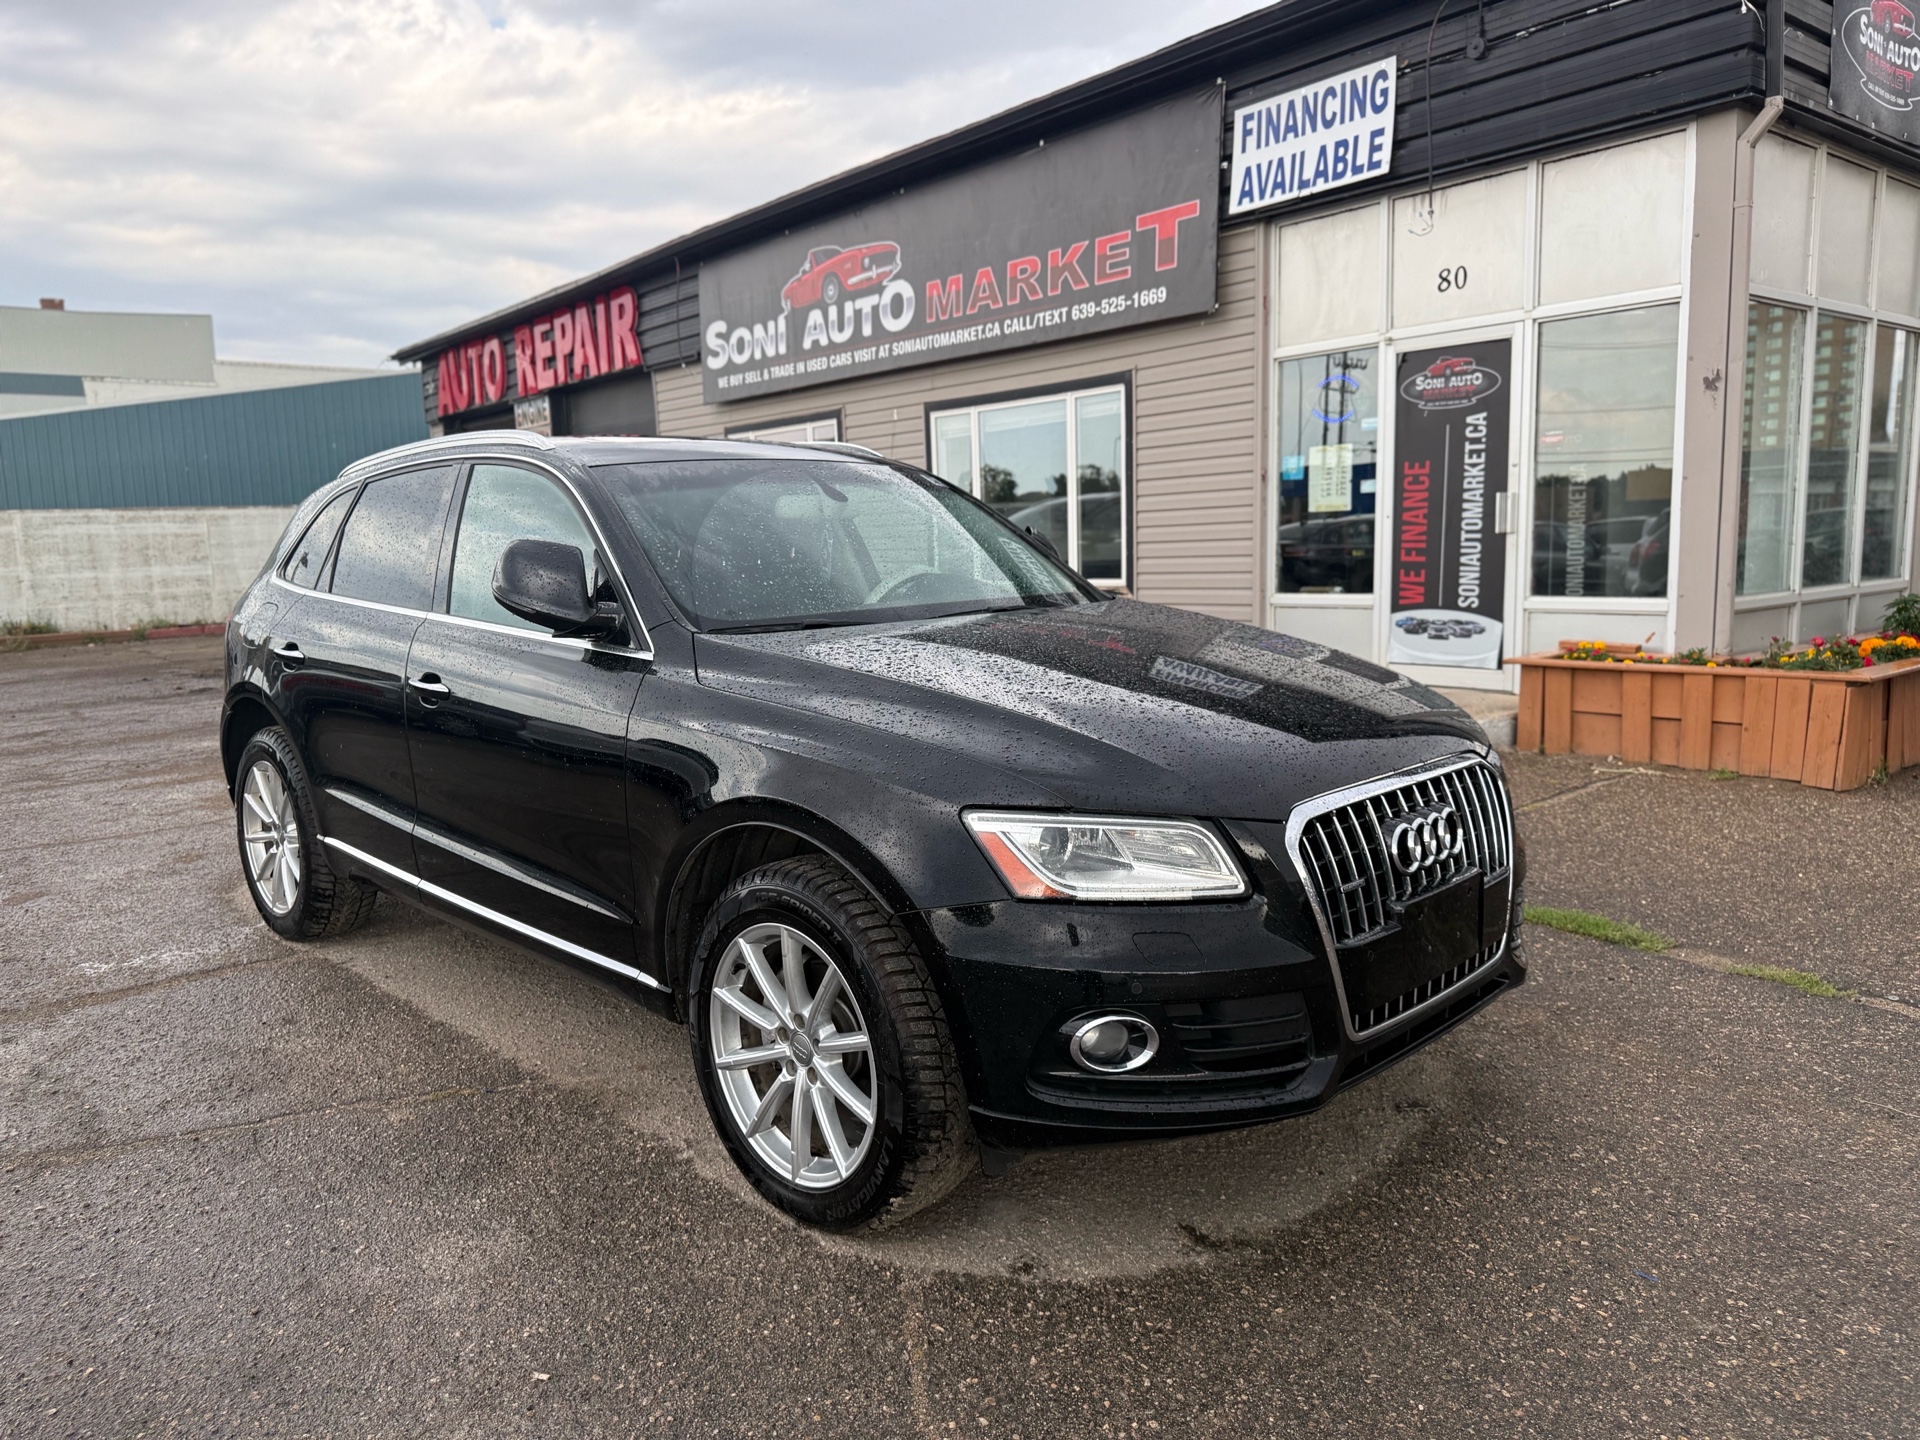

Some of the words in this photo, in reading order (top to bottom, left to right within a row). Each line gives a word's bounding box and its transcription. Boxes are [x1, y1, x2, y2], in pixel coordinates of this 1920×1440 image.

[1860, 14, 1883, 56] SONI
[1887, 41, 1920, 71] AUTO
[1241, 68, 1390, 154] FINANCING
[1237, 126, 1386, 207] AVAILABLE
[706, 314, 787, 370] SONI
[802, 279, 915, 350] AUTO
[926, 199, 1200, 323] MARKET
[1437, 265, 1468, 293] 80
[438, 332, 507, 417] AUTO
[514, 285, 643, 397] REPAIR
[718, 376, 729, 389] WE
[730, 374, 743, 387] BUY
[745, 371, 762, 384] SELL
[763, 368, 769, 380] &
[770, 363, 795, 379] TRADE
[796, 362, 805, 374] IN
[807, 357, 828, 372] USED
[830, 352, 852, 368] CARS
[854, 347, 876, 363] VISIT
[878, 344, 891, 359] AT
[892, 321, 1001, 356] SONIAUTOMARKET.CA
[1004, 306, 1069, 334] CALL/TEXT
[1072, 286, 1167, 320] 639-525-1669
[517, 399, 548, 427] ENGINE
[1415, 376, 1445, 390] SONI
[1449, 372, 1483, 387] AUTO
[1400, 460, 1430, 562] FINANCE
[1457, 411, 1488, 608] SONIAUTOMARKET.CA
[1565, 463, 1588, 596] ONIAUTOMARKET.CA
[1398, 569, 1426, 605] WE
